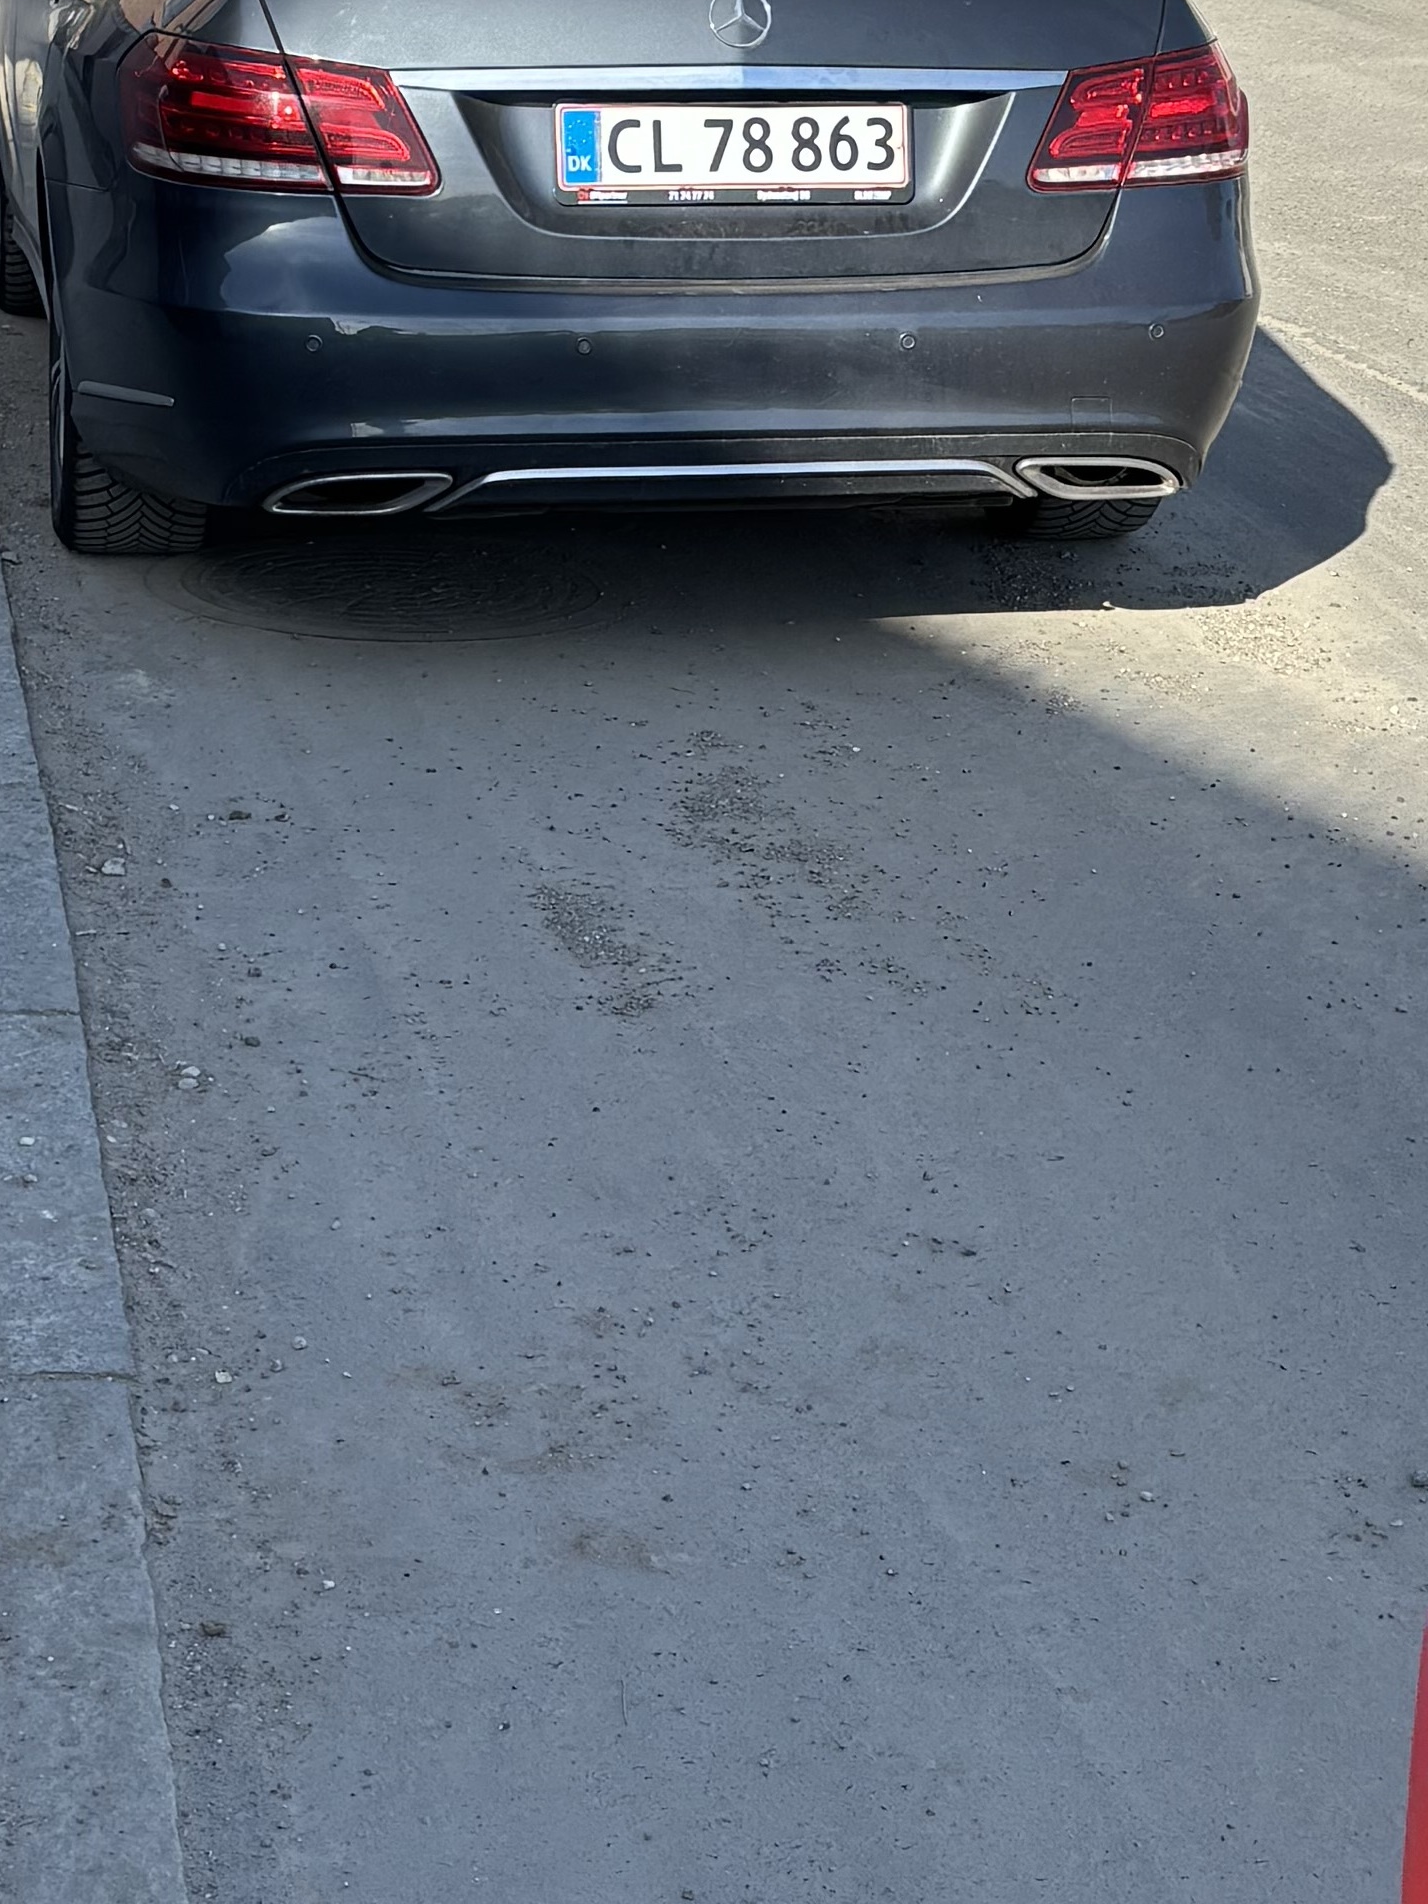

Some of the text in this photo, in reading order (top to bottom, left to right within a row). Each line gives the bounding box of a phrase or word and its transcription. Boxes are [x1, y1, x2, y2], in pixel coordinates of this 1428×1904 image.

[607, 115, 896, 174] CL 78 863
[567, 155, 592, 173] DK
